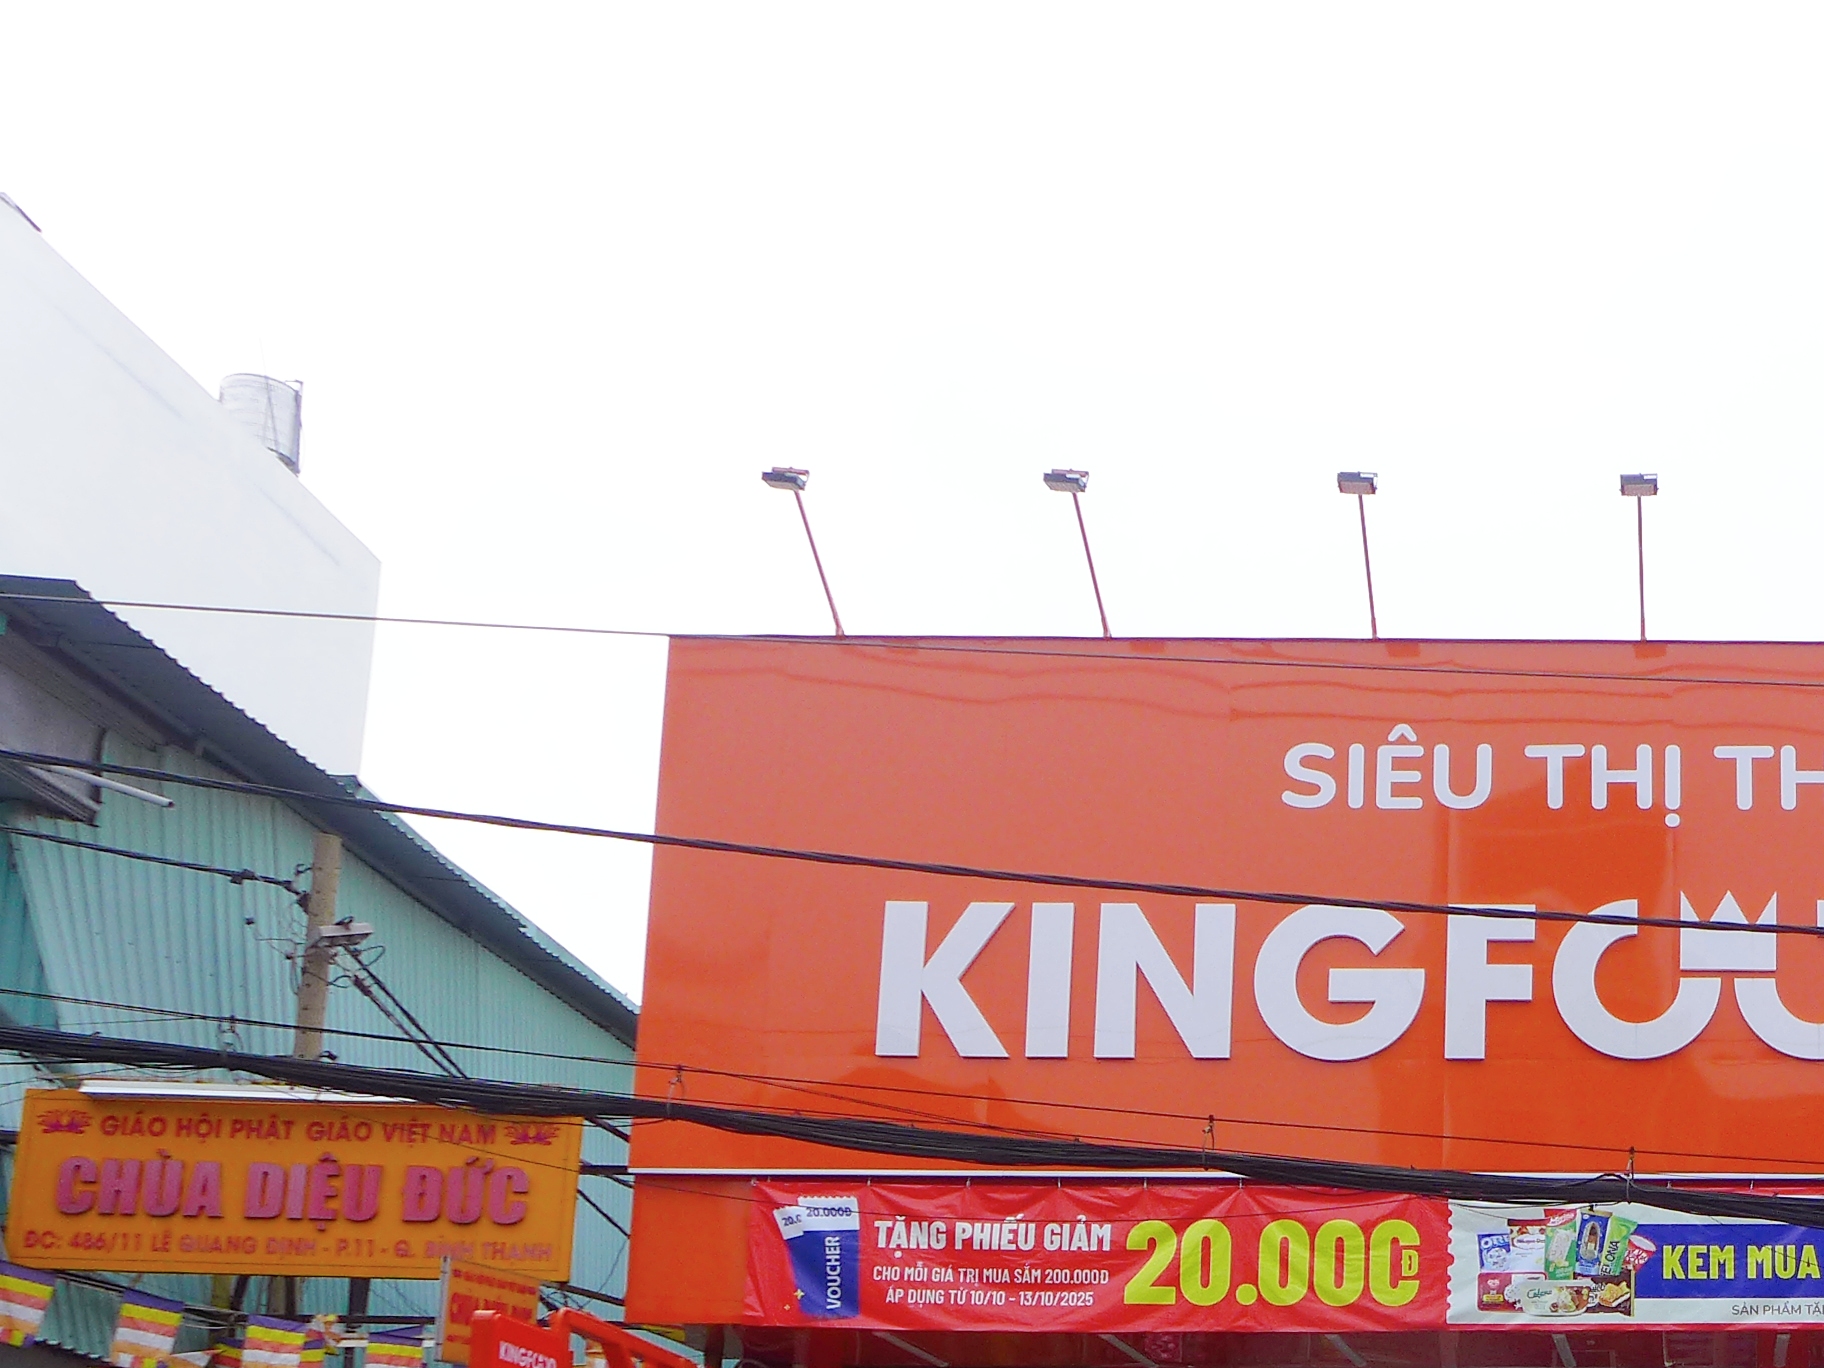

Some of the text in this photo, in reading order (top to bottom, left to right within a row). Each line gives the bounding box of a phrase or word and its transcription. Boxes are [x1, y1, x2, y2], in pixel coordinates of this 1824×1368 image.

[1281, 724, 1494, 811] SIÊU
[1525, 742, 1681, 828] THỊ
[101, 1112, 497, 1147] GIÁO HỘI PHẬT GIÁO VIỆT NAM
[56, 1149, 531, 1231] CHÙA DIỆU ĐỨC
[151, 1231, 171, 1253] LÊ
[874, 1213, 1112, 1258] TẶNG PHIẾU GIẢM
[825, 1235, 841, 1310] VOUCHER
[873, 1265, 900, 1282] CHO
[904, 1261, 927, 1282] MỖI
[931, 1264, 954, 1283] GIÁ
[958, 1267, 979, 1287] TRỊ
[983, 1268, 1010, 1283] MUA
[1014, 1263, 1040, 1284] SẮM
[1662, 1244, 1736, 1281] KEM
[1746, 1244, 1821, 1280] MUA
[886, 1285, 1094, 1308] ÁP DỤNG TỪ 10/10 13/10/2025
[1731, 1300, 1759, 1316] SẢN
[1762, 1298, 1801, 1316] PHẨM
